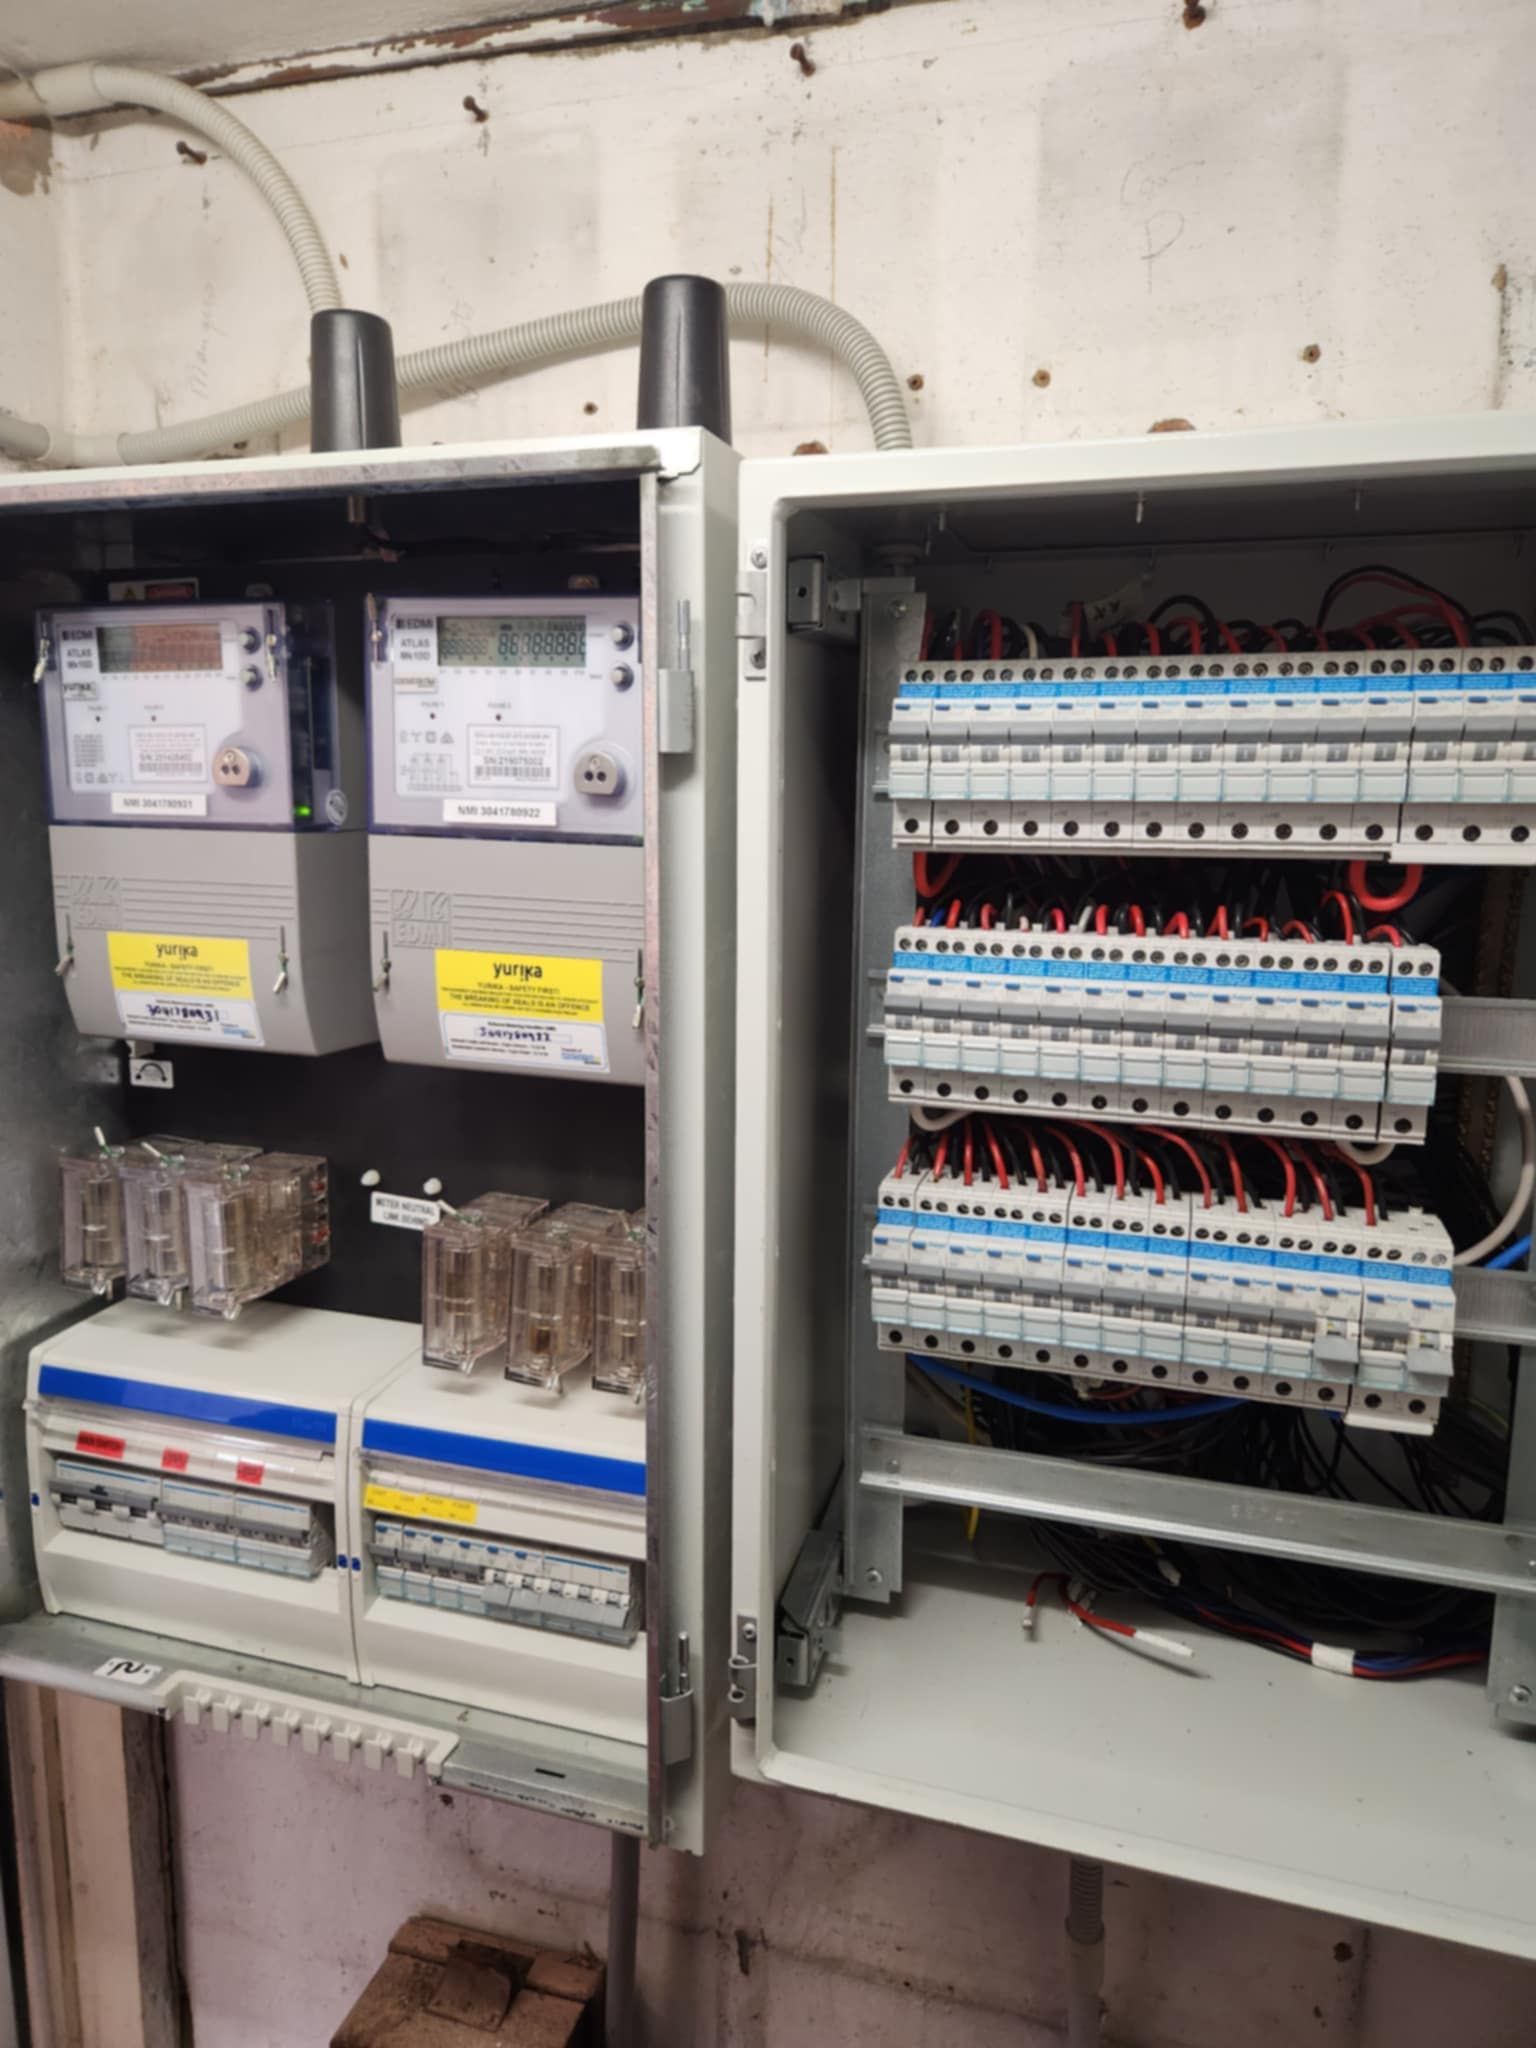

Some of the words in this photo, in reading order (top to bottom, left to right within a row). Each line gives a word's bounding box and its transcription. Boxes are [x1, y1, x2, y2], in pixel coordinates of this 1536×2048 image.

[401, 638, 430, 649] ATLAS
[156, 943, 199, 960] yurika
[493, 961, 543, 982] yurika
